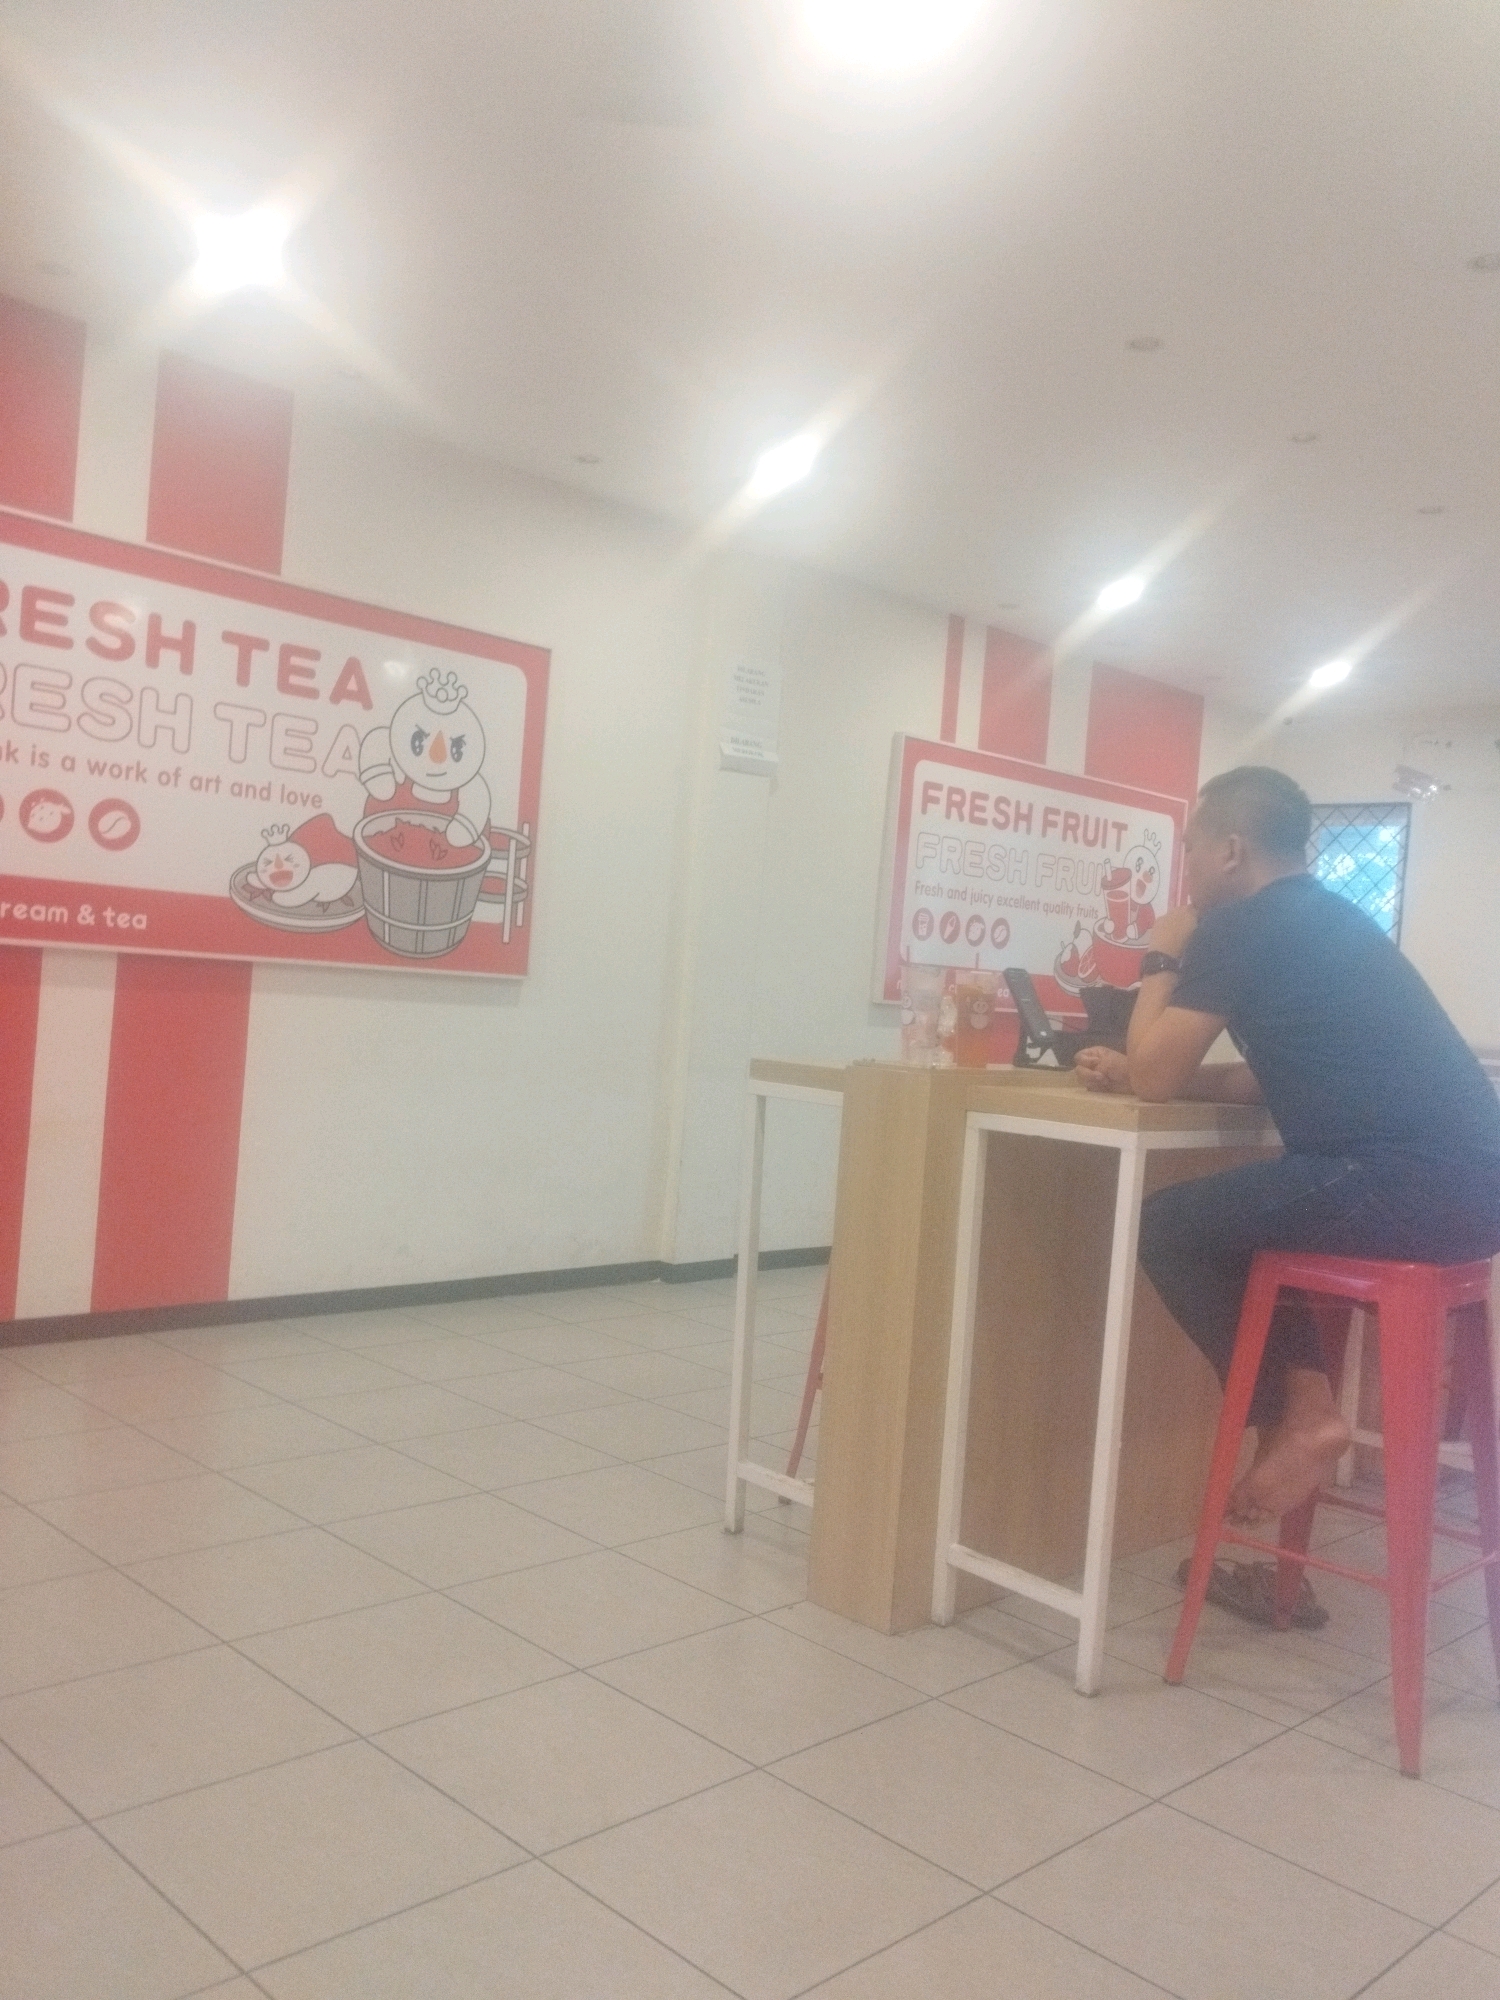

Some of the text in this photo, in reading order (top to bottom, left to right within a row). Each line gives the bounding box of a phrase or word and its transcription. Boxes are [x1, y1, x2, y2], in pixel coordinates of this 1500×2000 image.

[0, 580, 373, 711] ESH TEA
[0, 662, 363, 784] ESH TEA
[30, 744, 50, 768] is
[61, 754, 76, 773] a
[87, 759, 148, 783] work
[157, 766, 182, 788] of
[190, 775, 222, 794] art
[230, 781, 272, 801] and
[280, 783, 323, 809] love
[921, 781, 1128, 852] FRESH FRUIT
[916, 832, 1106, 897] FRESH FRUI
[77, 904, 95, 926] &
[103, 906, 148, 930] tea
[915, 880, 1099, 919] Fresh and juicy excellent quality fruits
